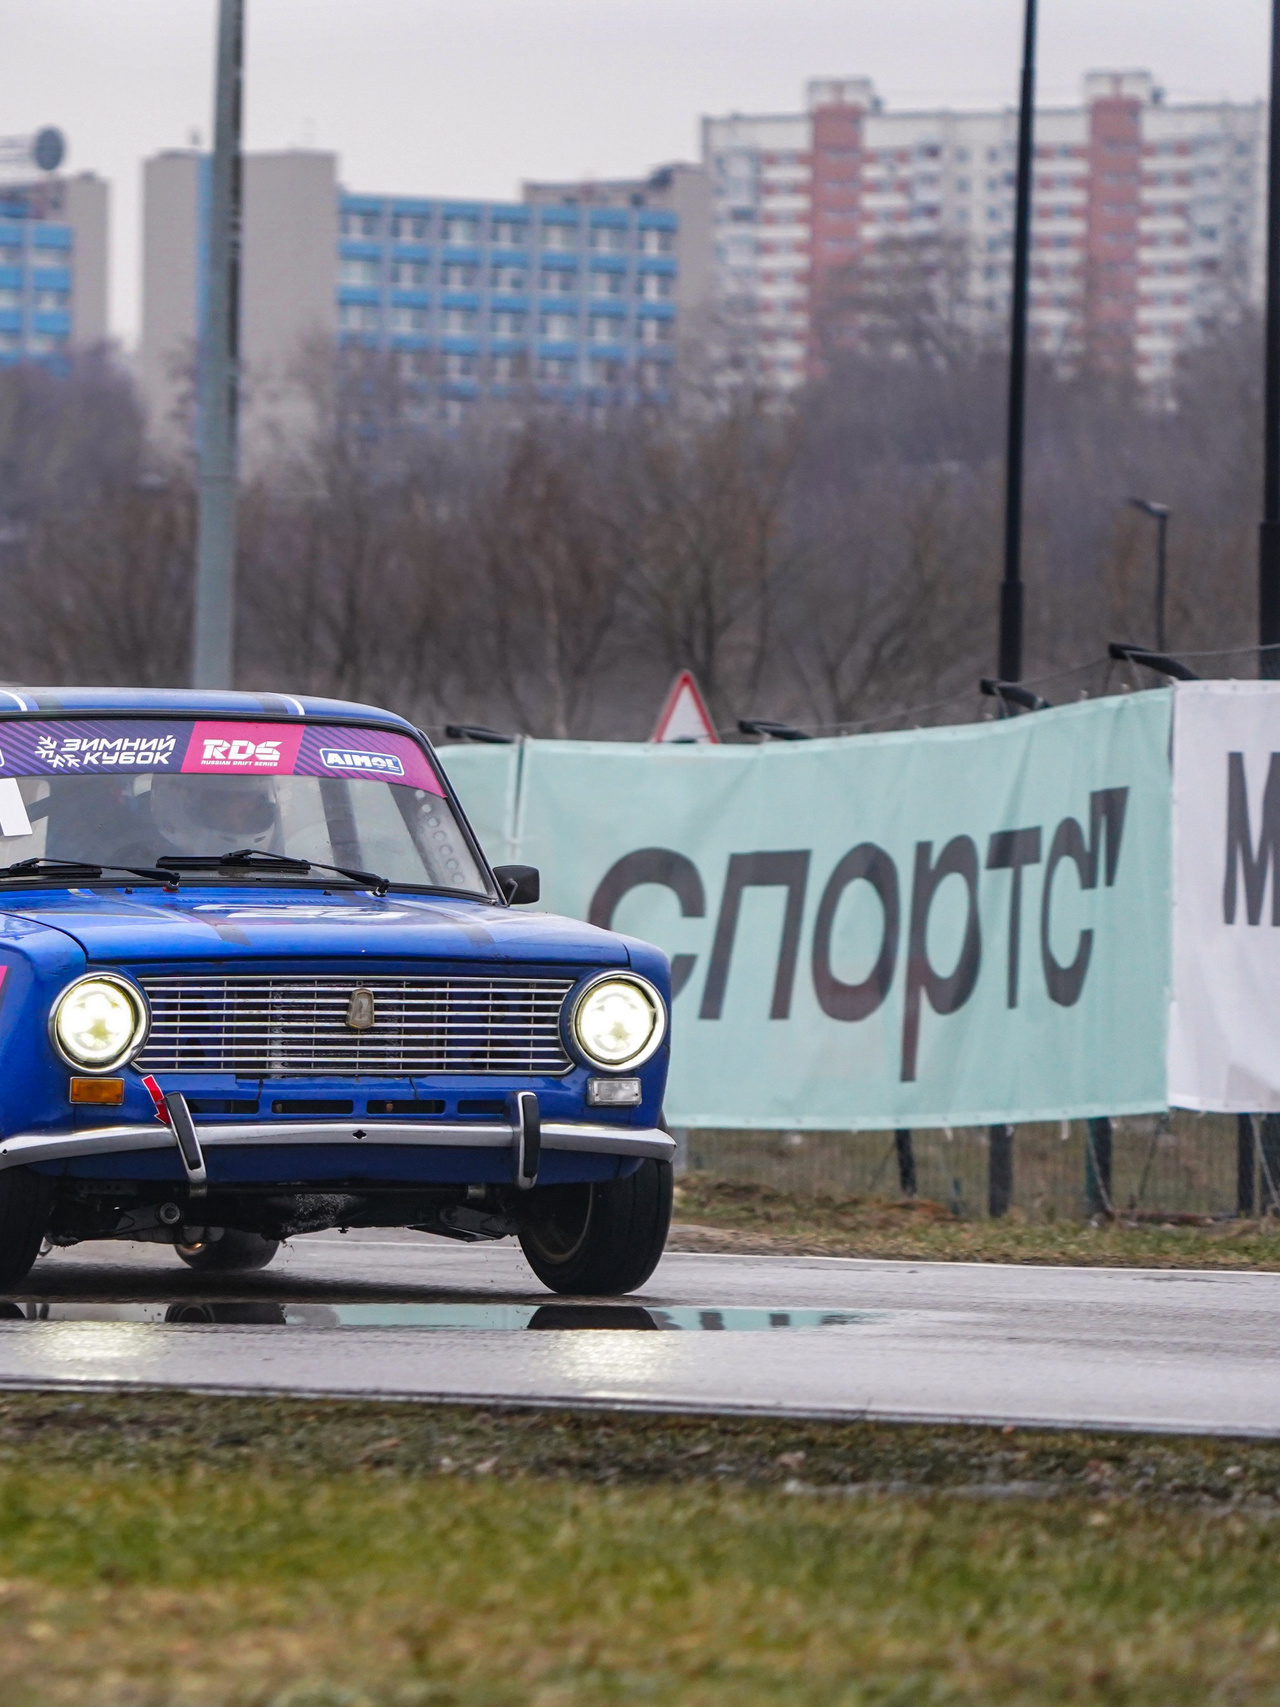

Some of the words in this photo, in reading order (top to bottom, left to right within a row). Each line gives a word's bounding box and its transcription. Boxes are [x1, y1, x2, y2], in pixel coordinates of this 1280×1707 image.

[61, 735, 176, 751] ЗИМНИЙ
[202, 739, 283, 760] RDS
[83, 751, 173, 765] КУБОК
[327, 752, 401, 772] AIMOL
